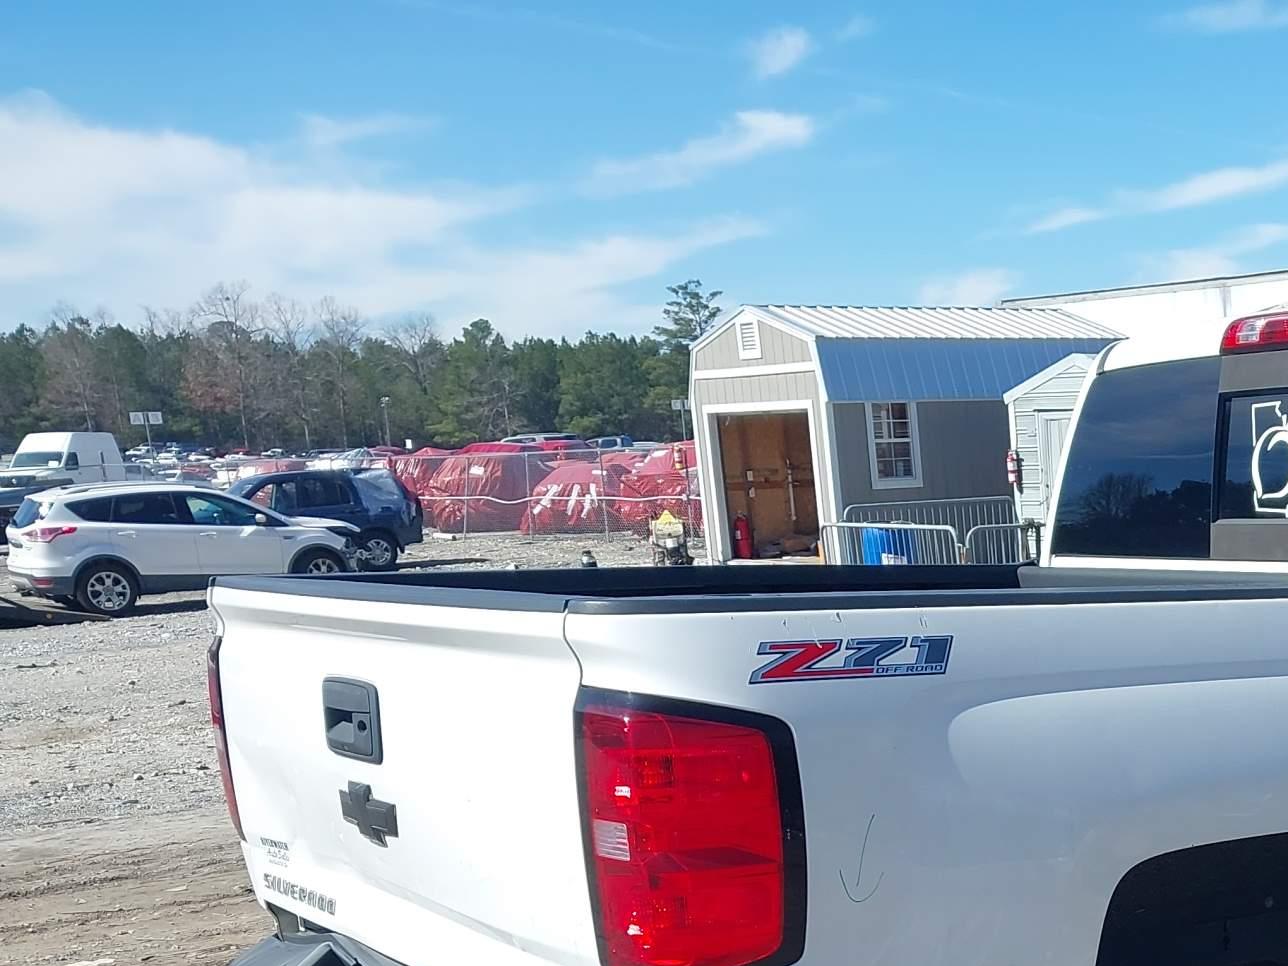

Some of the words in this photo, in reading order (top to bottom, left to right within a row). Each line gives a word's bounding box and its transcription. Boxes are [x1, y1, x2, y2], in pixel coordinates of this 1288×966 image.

[748, 635, 954, 685] Z71
[875, 666, 903, 675] OFF
[905, 664, 944, 674] ROAD
[263, 873, 337, 916] SILVERADO
